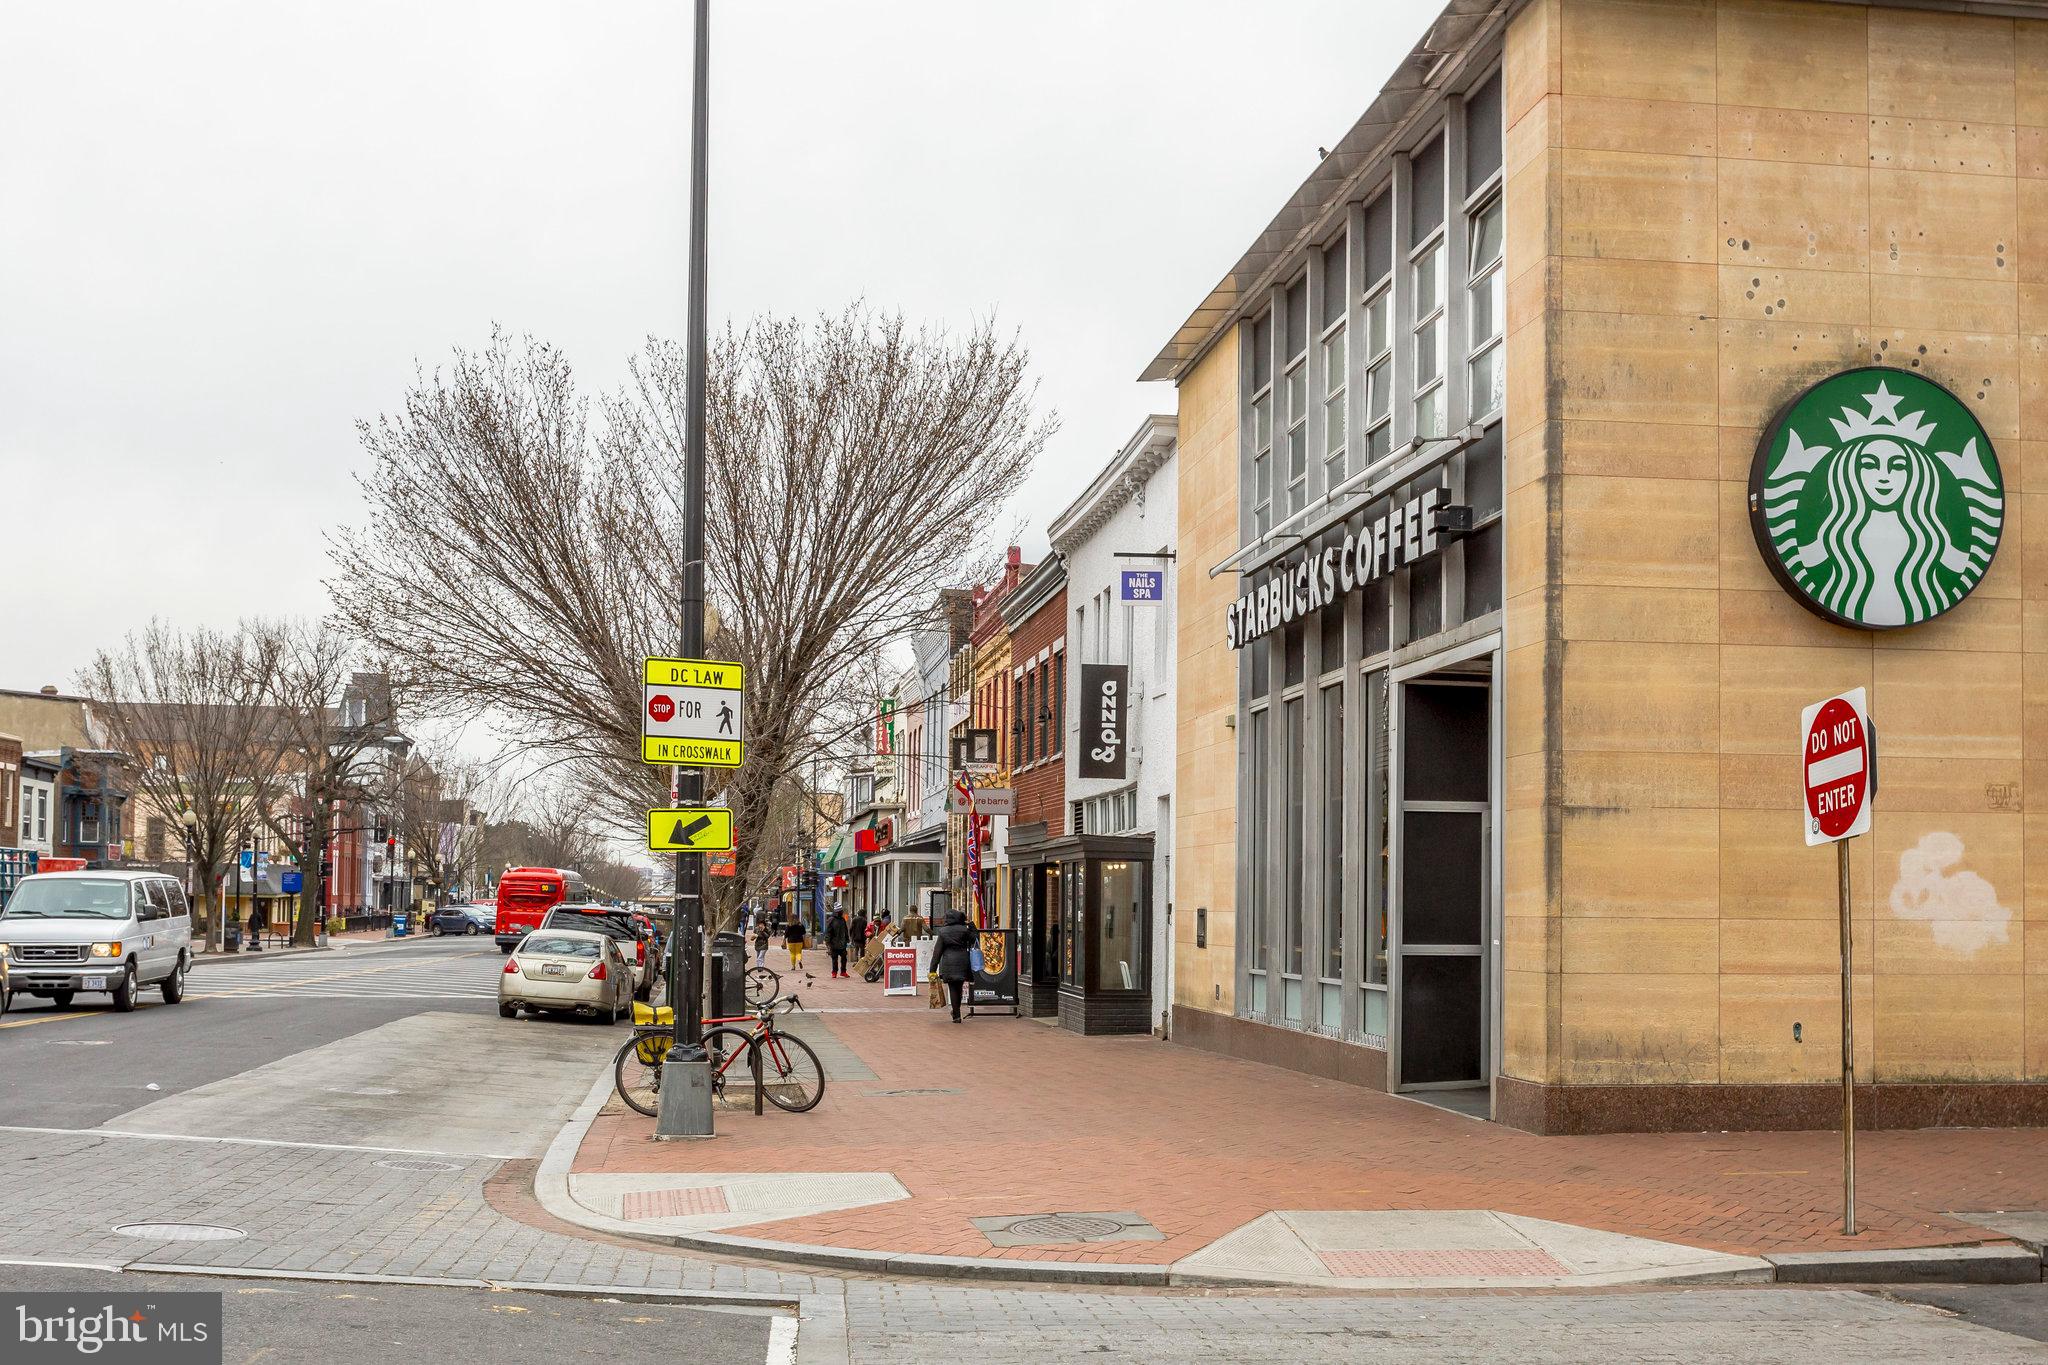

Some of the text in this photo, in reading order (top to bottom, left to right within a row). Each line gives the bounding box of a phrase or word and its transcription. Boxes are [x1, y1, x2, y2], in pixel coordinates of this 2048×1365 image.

[1226, 487, 1440, 651] STARBUCKS COFFEE
[1128, 577, 1156, 588] NAILS
[1133, 588, 1151, 599] SPA
[670, 668, 724, 685] DC LAW
[653, 700, 702, 719] STOP FOR
[1091, 680, 1121, 763] &pizza
[1811, 717, 1857, 754] DO NOT
[657, 744, 731, 761] IN CROSSWALK
[987, 797, 1009, 805] barre
[1817, 783, 1856, 815] ENTER
